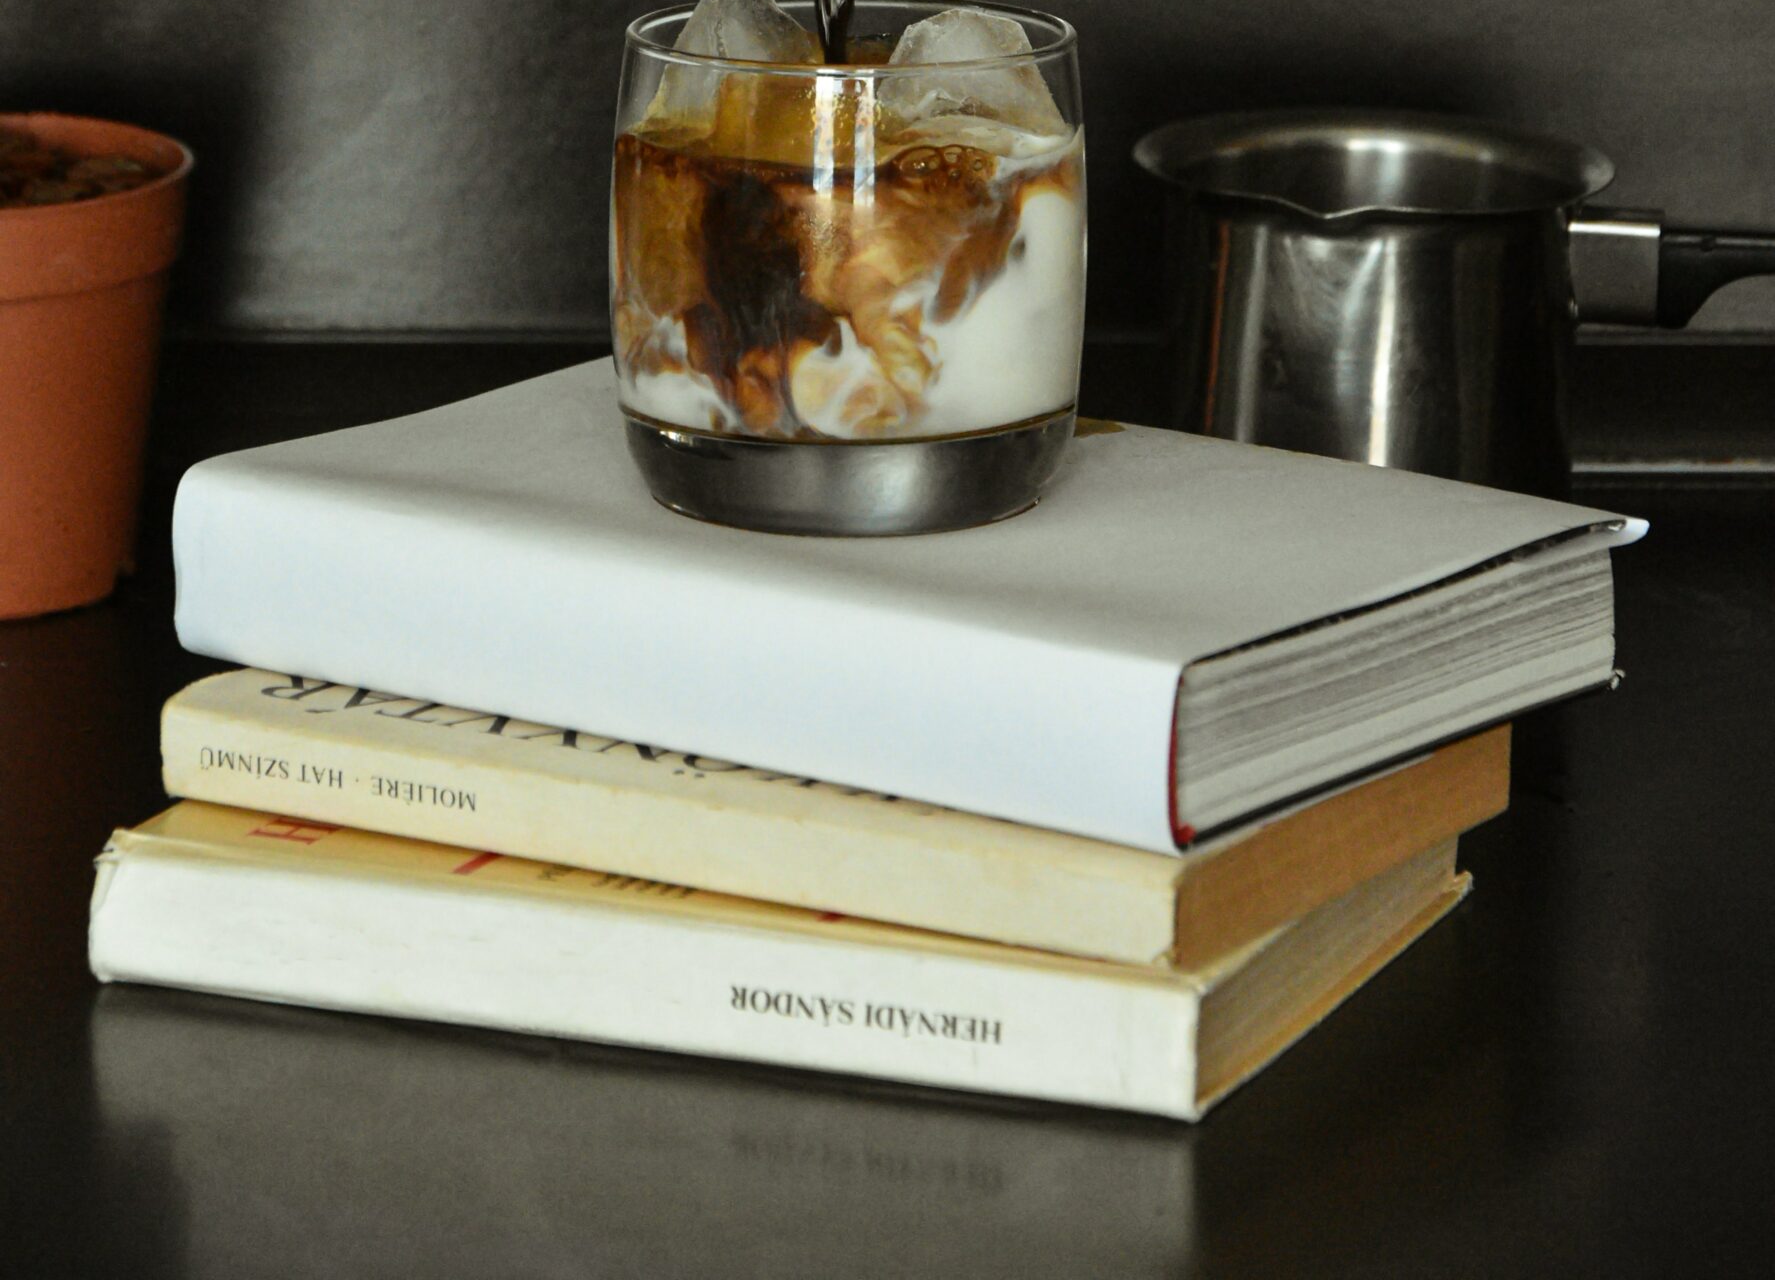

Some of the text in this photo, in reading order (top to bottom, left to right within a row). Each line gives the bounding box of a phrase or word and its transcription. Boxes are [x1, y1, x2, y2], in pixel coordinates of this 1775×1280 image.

[298, 763, 343, 789] HAT
[371, 777, 476, 812] MOLIÈRE
[730, 985, 1002, 1045] HERNÁDI SÁNDOR
